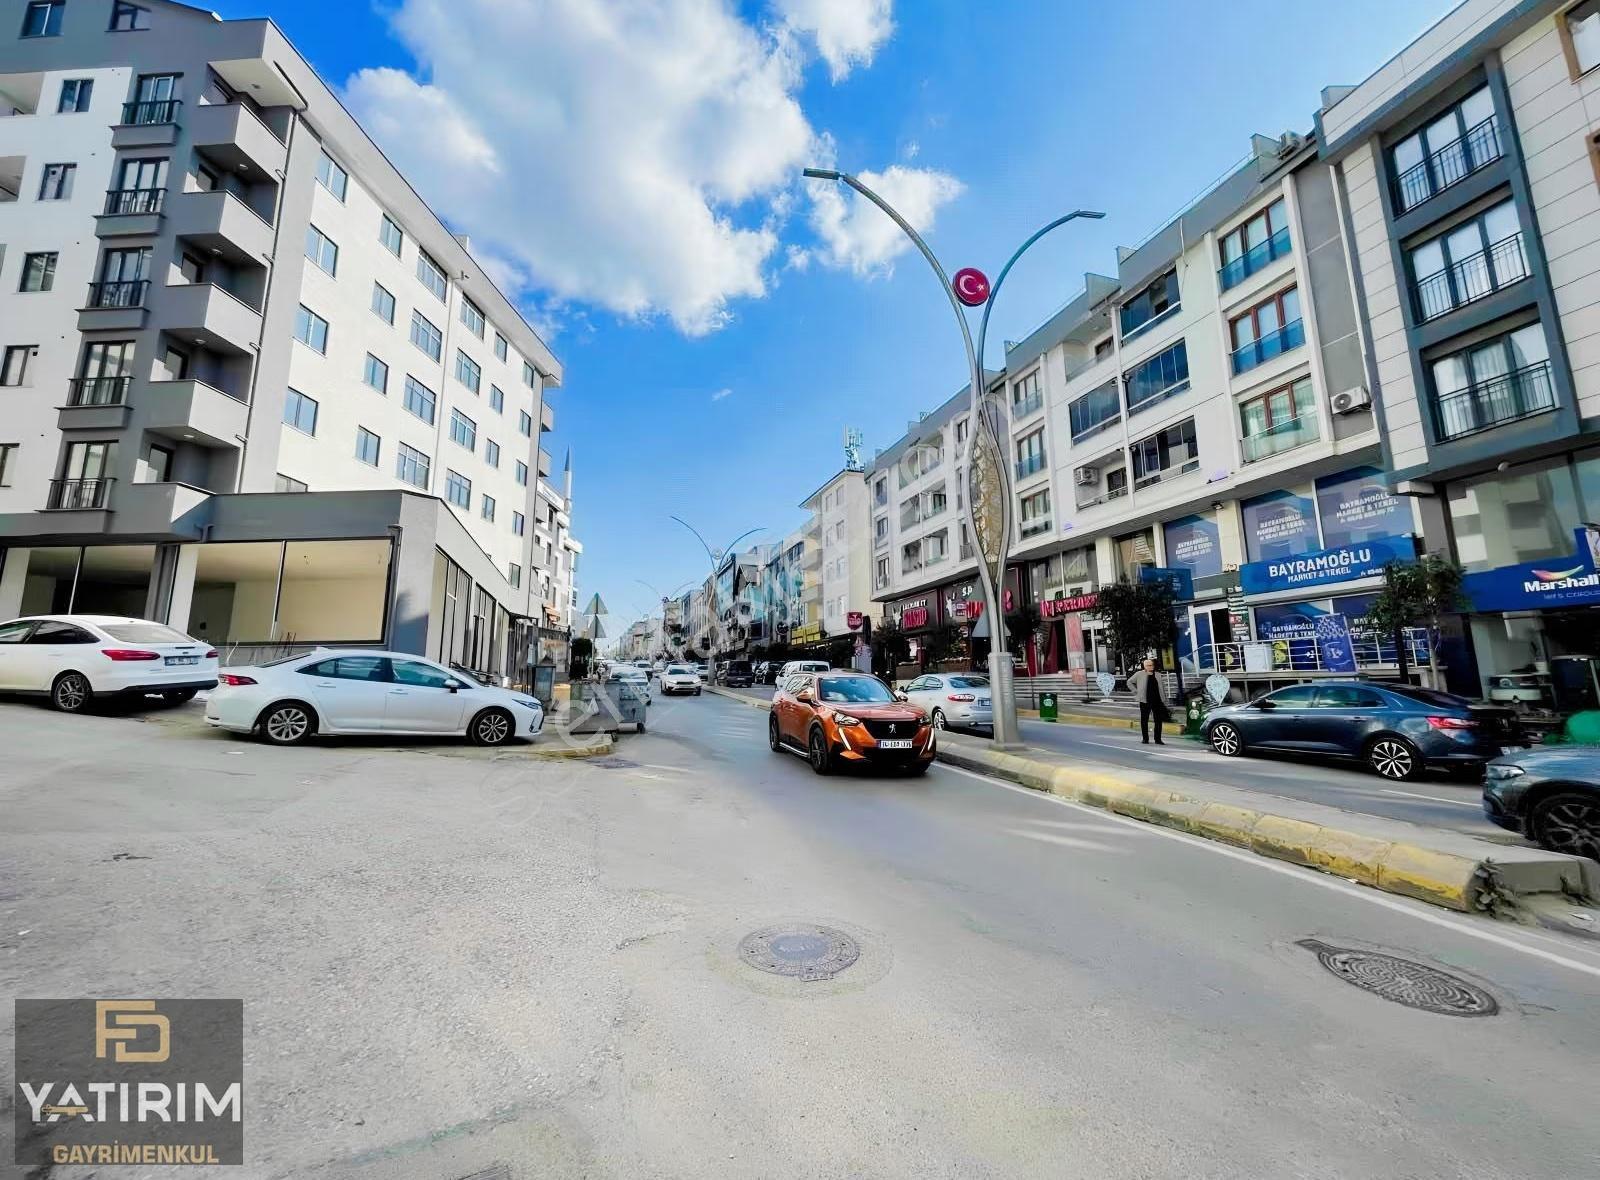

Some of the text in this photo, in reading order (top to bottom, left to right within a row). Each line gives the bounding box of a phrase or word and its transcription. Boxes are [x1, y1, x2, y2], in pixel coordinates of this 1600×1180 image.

[1269, 548, 1371, 577] BAYRAMOĞLU
[1288, 571, 1317, 583] MARKET
[1326, 567, 1351, 577] TEKEL
[1524, 574, 1599, 593] Marshall
